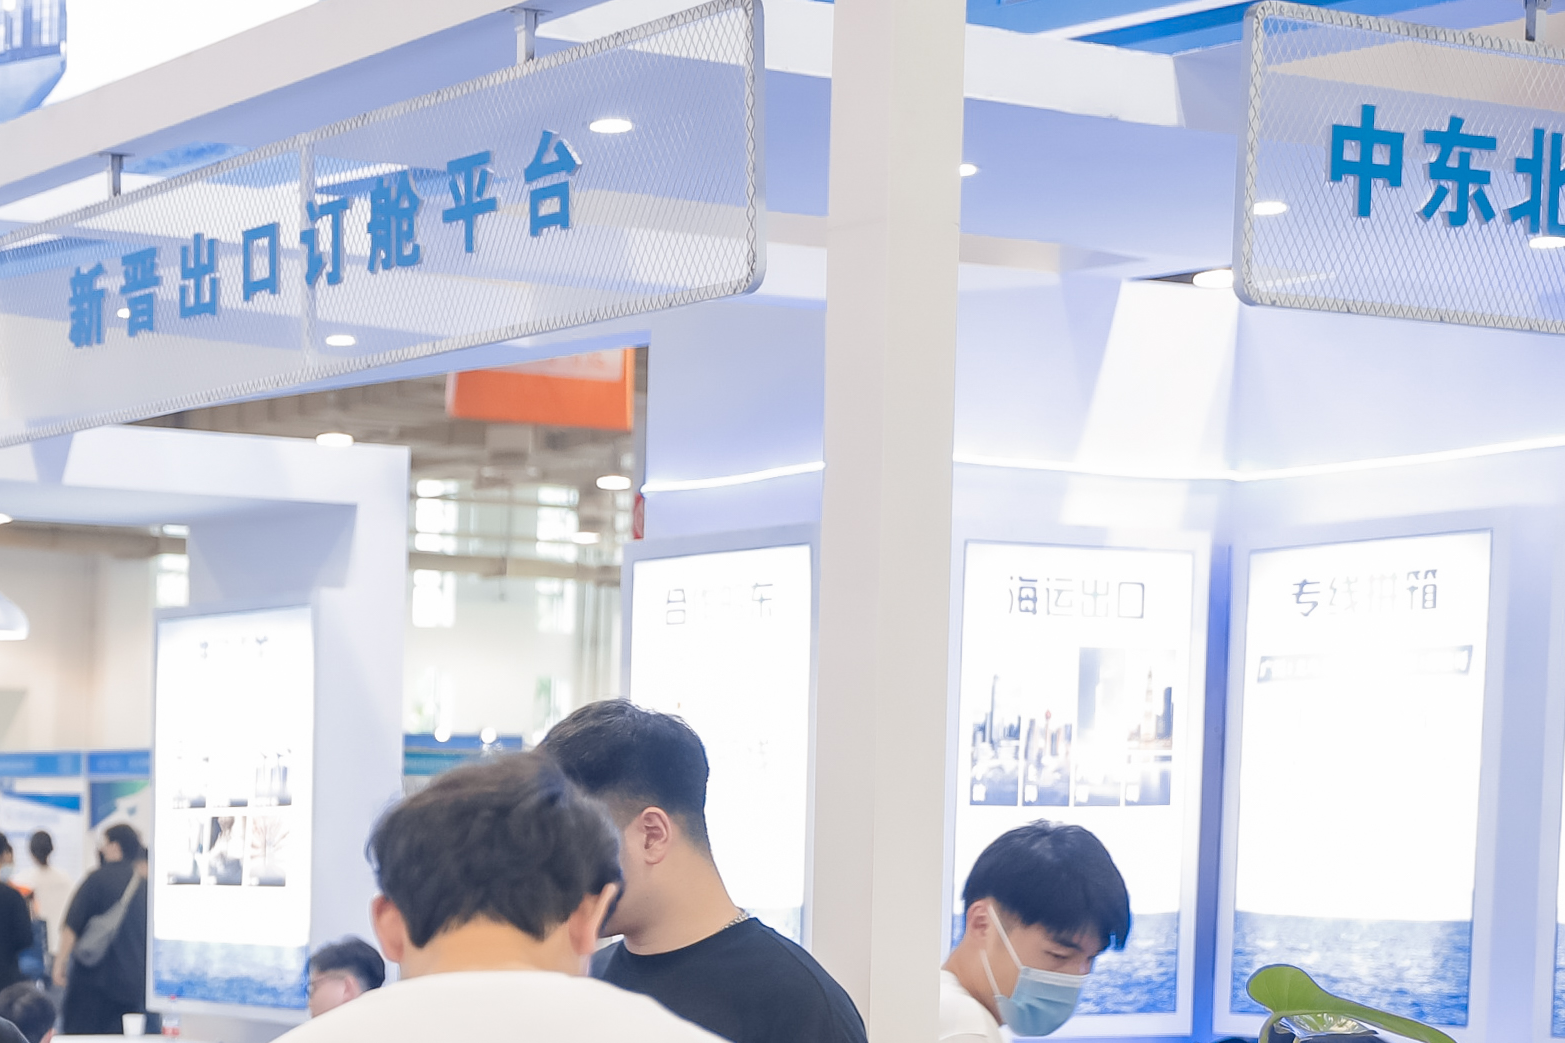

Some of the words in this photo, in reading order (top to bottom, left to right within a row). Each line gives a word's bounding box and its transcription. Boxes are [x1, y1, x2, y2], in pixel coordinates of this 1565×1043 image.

[67, 129, 583, 350] 新晋出口订舱平台
[1327, 103, 1565, 238] 中东北
